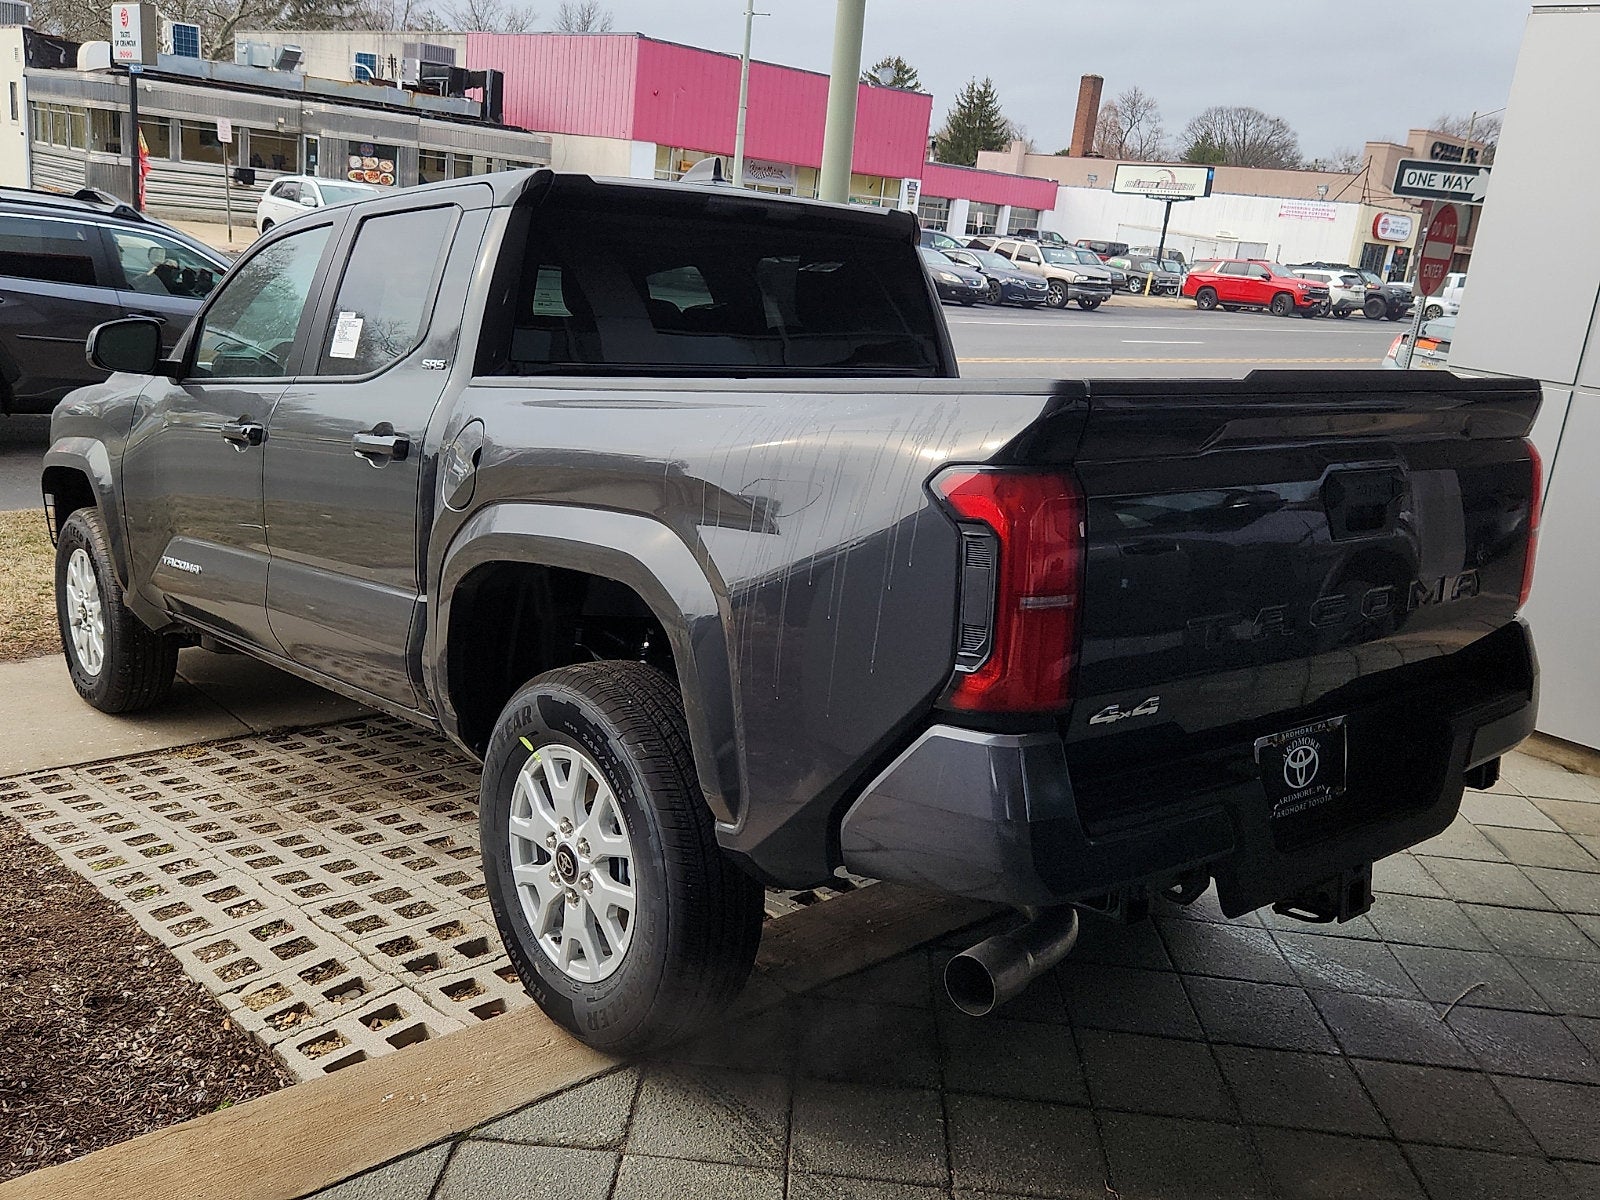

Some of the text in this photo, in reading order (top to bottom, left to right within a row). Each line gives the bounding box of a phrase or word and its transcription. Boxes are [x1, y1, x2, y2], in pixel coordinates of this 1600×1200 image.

[1407, 171, 1474, 191] ONE WAY
[1431, 220, 1456, 238] DO NOT
[1423, 263, 1443, 278] ENTER
[161, 554, 203, 575] TACOMA
[1186, 568, 1481, 650] TACOMA
[1282, 736, 1321, 762] ARDMORE
[1276, 794, 1332, 819] ARDMORE TOYOTA
